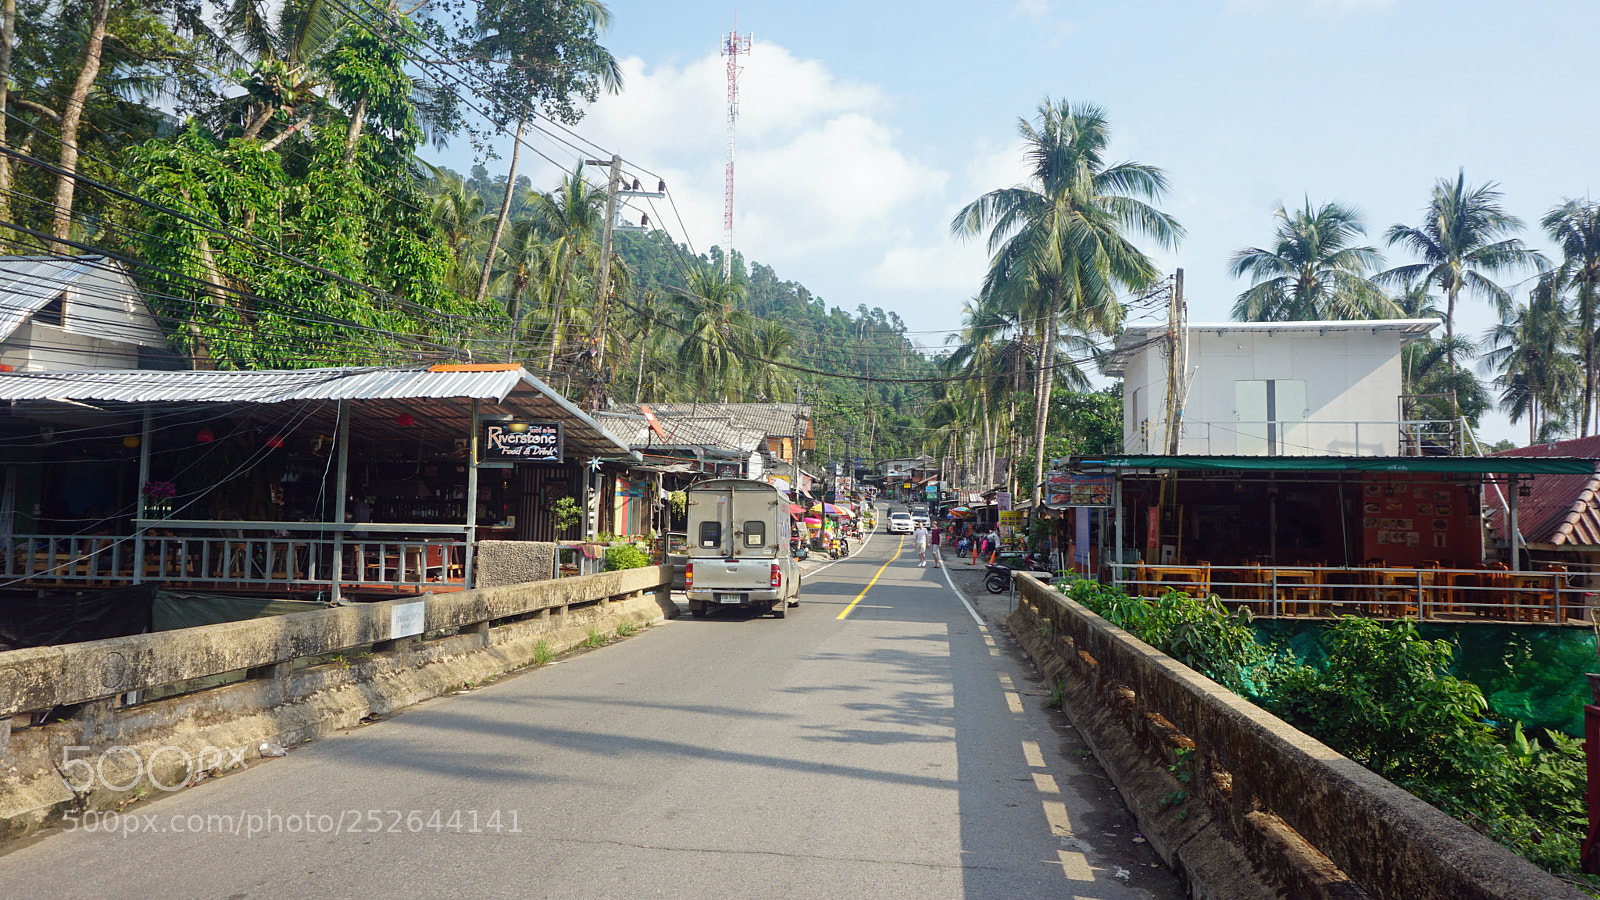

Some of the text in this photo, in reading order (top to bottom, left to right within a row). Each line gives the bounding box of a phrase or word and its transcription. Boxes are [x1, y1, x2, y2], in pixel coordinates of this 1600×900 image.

[487, 426, 557, 449] Riverstone
[501, 446, 554, 456] Food & Drink
